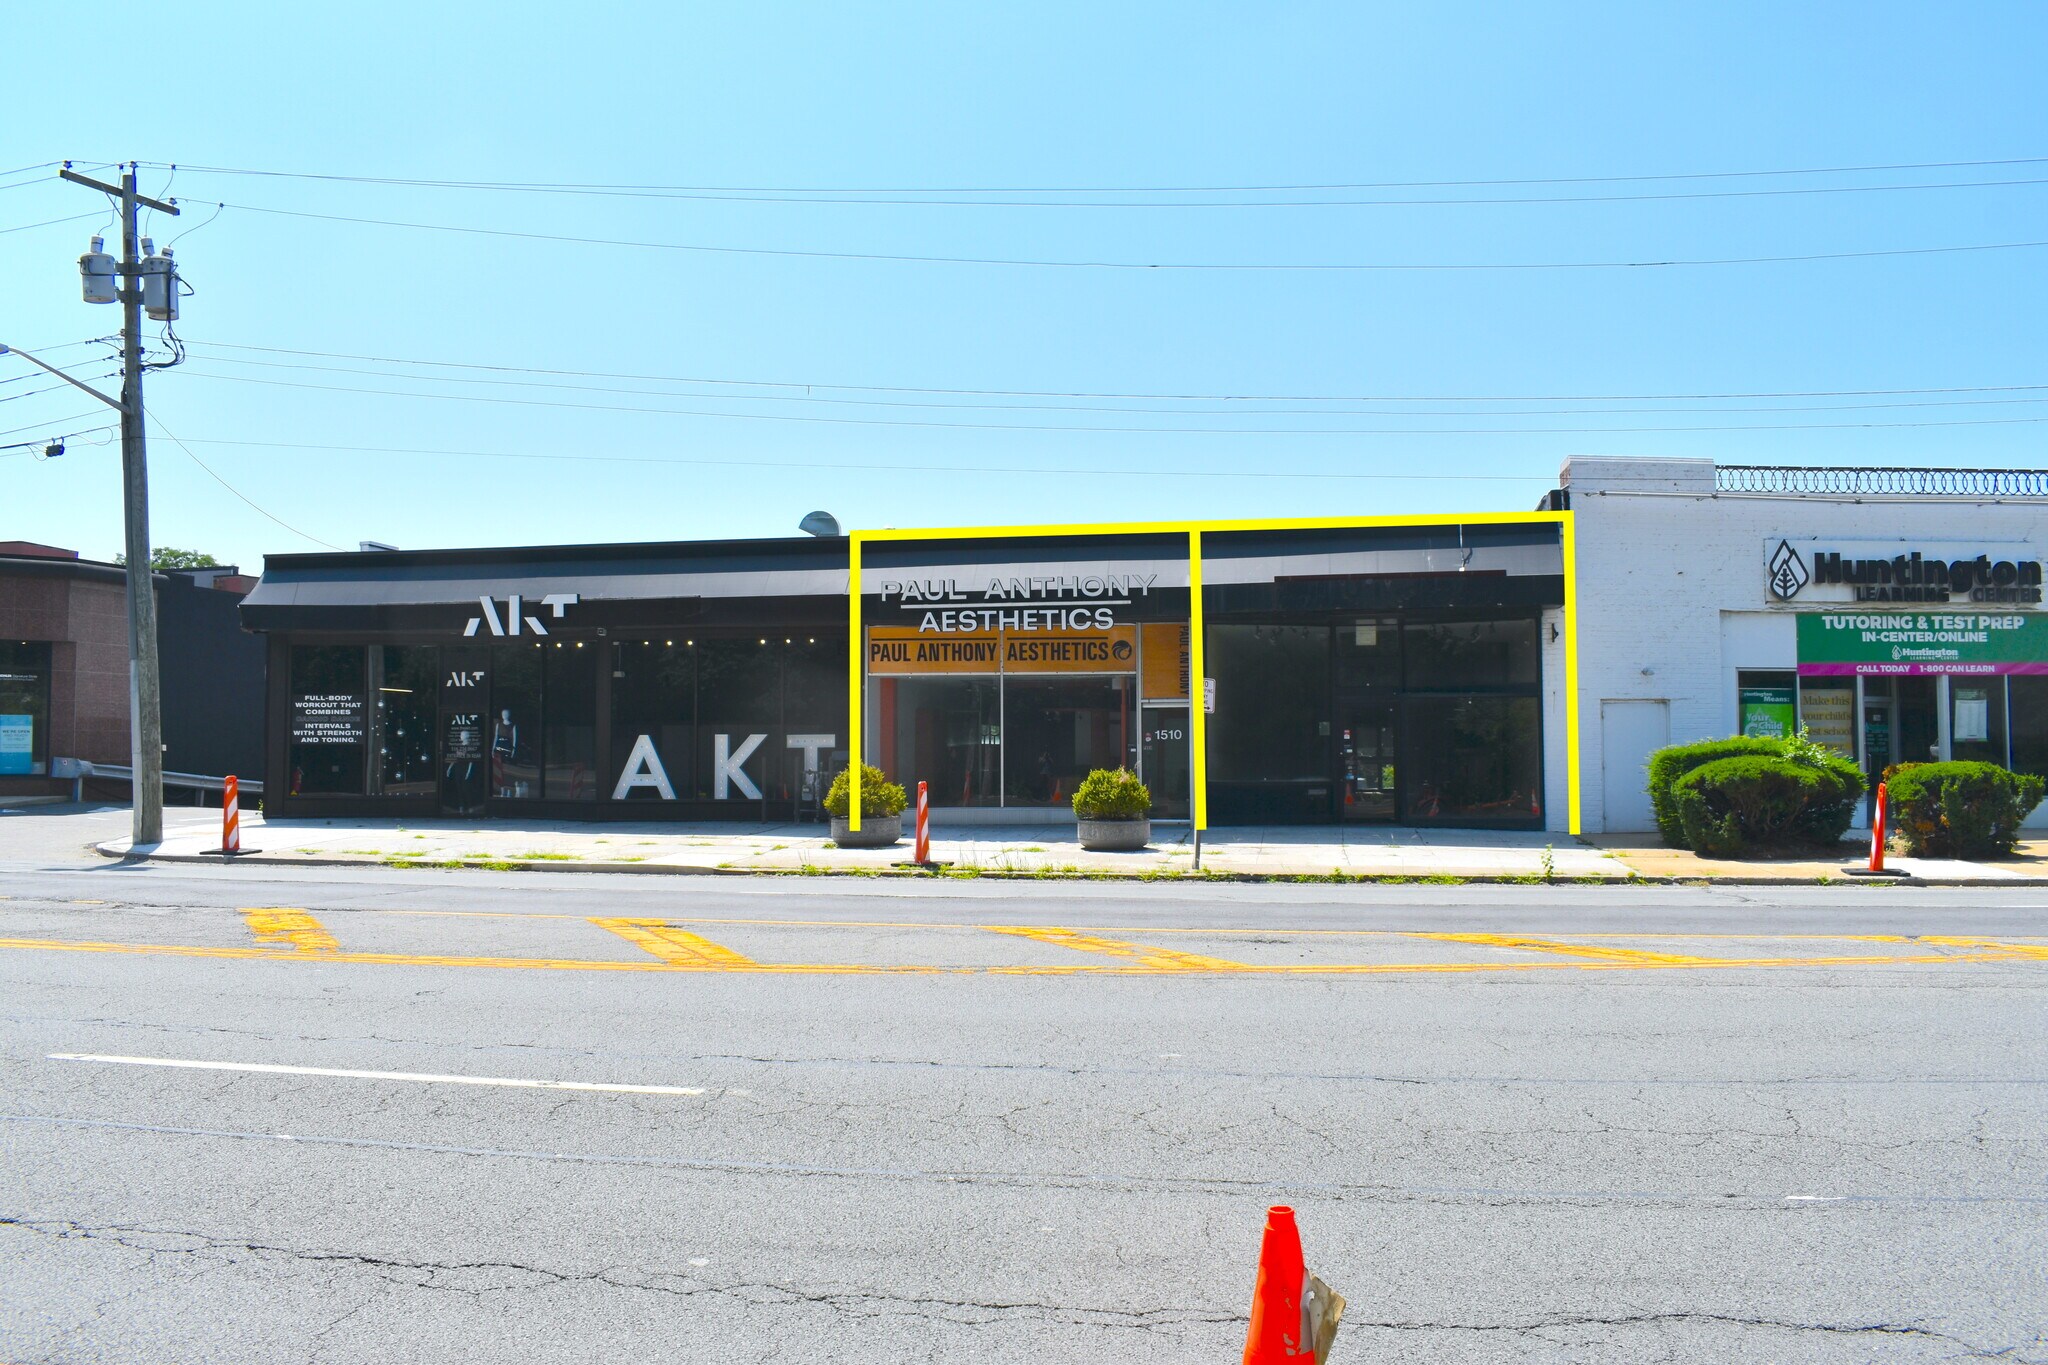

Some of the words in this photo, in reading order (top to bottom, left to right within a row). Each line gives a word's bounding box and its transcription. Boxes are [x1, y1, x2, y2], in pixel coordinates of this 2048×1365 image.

[1814, 551, 2042, 593] Huntington
[882, 577, 968, 601] PAUL
[984, 574, 1158, 600] ANTHONY
[1856, 587, 1950, 602] LEARNING
[1973, 588, 2042, 602] CENTER
[463, 593, 579, 636] AKT
[919, 608, 1115, 632] AESTHETICS
[1822, 615, 1913, 630] TUTORING
[1917, 616, 1928, 630] &
[1931, 615, 1976, 630] TEST
[1978, 615, 2025, 630] PREP
[1180, 626, 1189, 647] PAUL
[1861, 631, 1988, 642] IN-CENTER/ONLINE
[871, 643, 913, 662] PAUL
[917, 642, 998, 662] ANTHONY
[1007, 641, 1110, 661] AESTHETICS
[1902, 647, 1958, 657] Huntington
[447, 671, 485, 687] AKT
[1180, 651, 1189, 694] ANTHONY
[1803, 696, 1829, 705] Make
[1831, 696, 1850, 705] this
[452, 714, 479, 725] AKT
[1746, 713, 1770, 721] Your
[1759, 721, 1783, 730] Child
[1154, 729, 1182, 740] 1510
